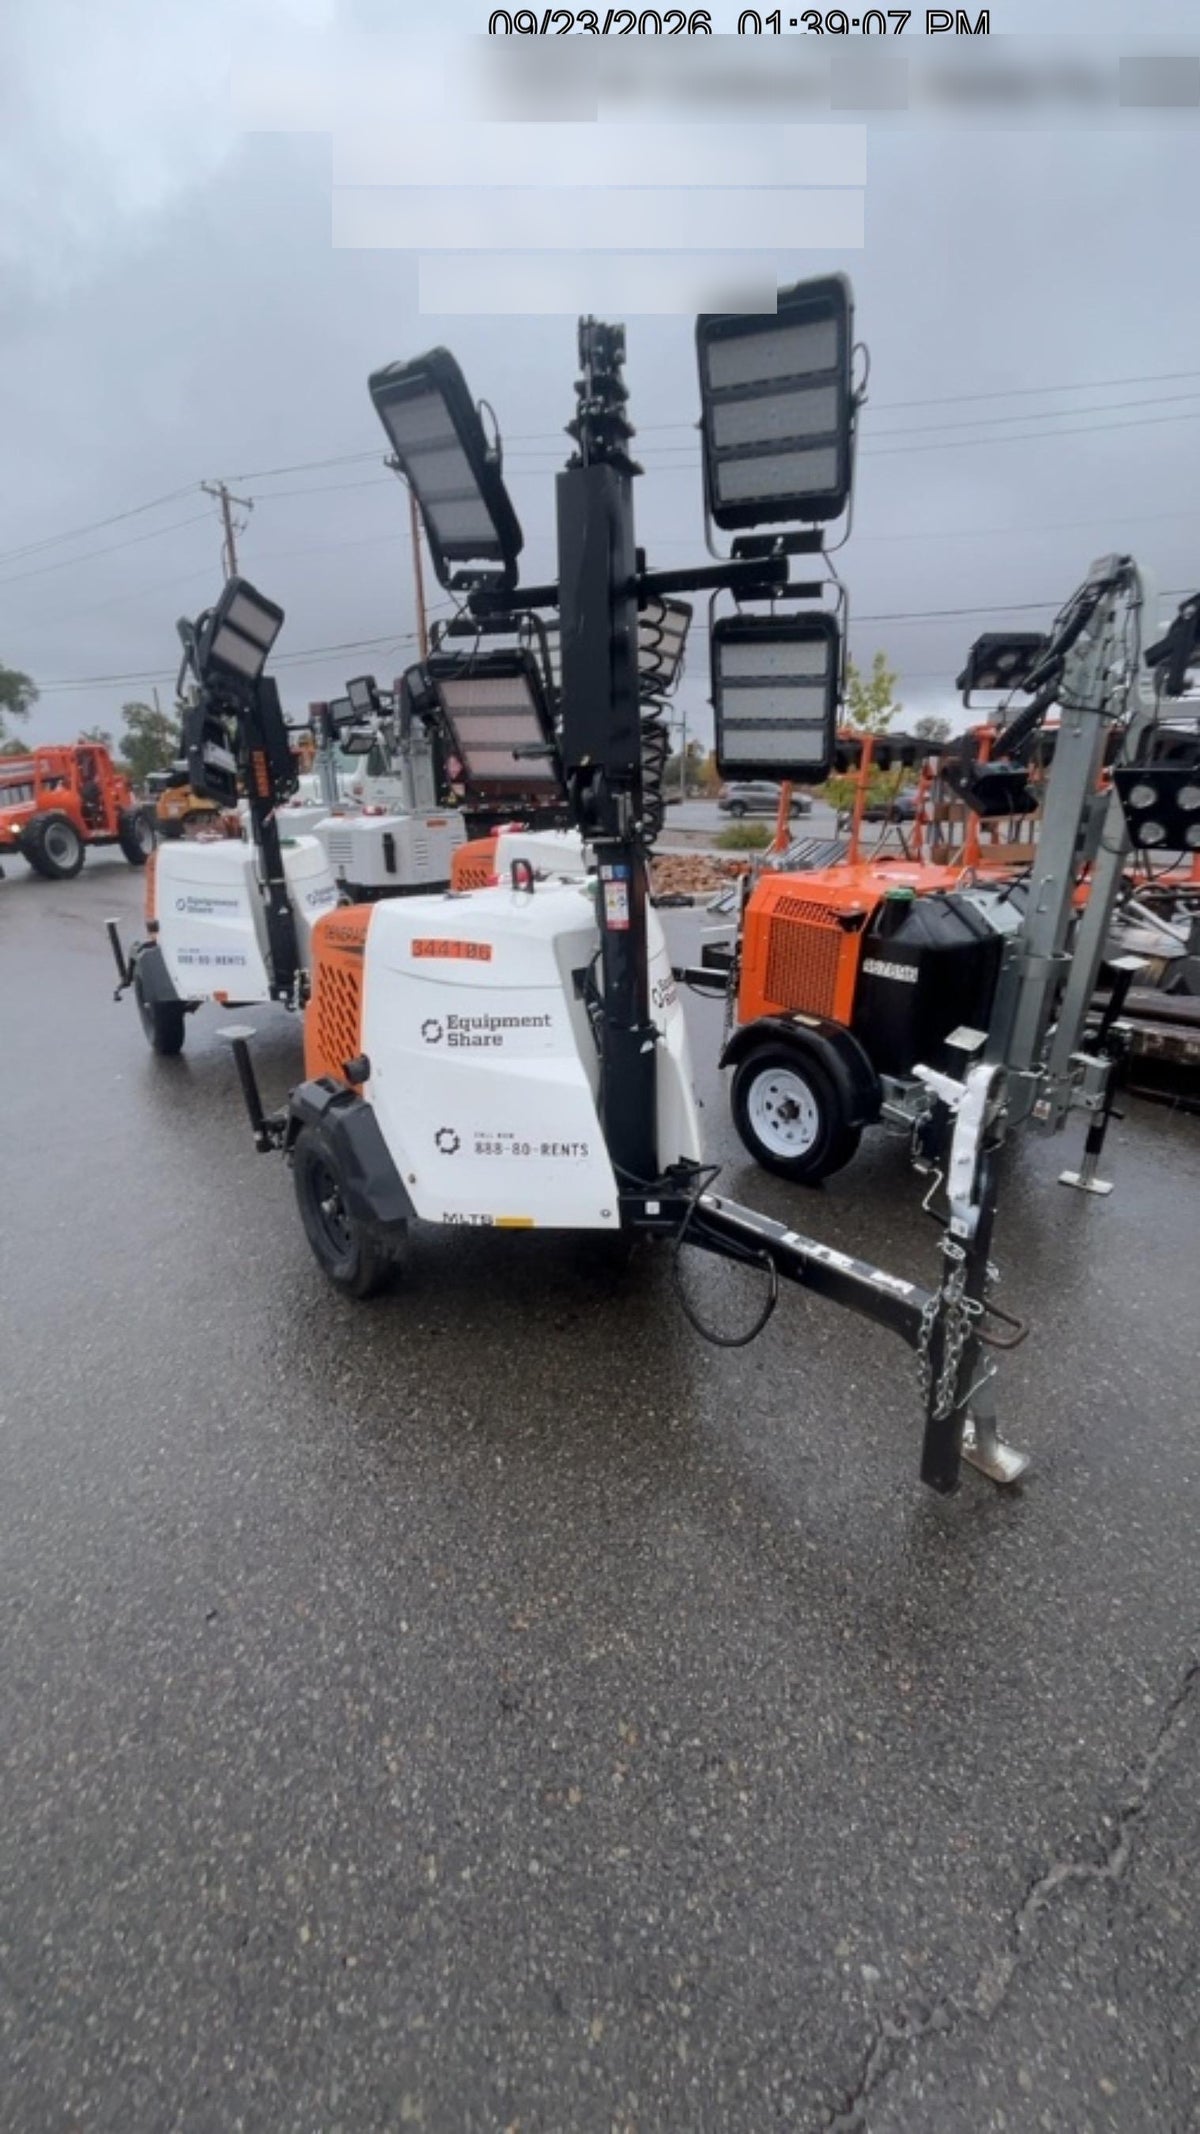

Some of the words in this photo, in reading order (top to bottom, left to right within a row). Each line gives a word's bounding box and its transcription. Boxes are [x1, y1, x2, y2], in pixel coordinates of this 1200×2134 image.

[446, 1013, 552, 1031] Equipment
[446, 1032, 503, 1048] Share
[475, 1141, 590, 1158] 888-80-RENTS
